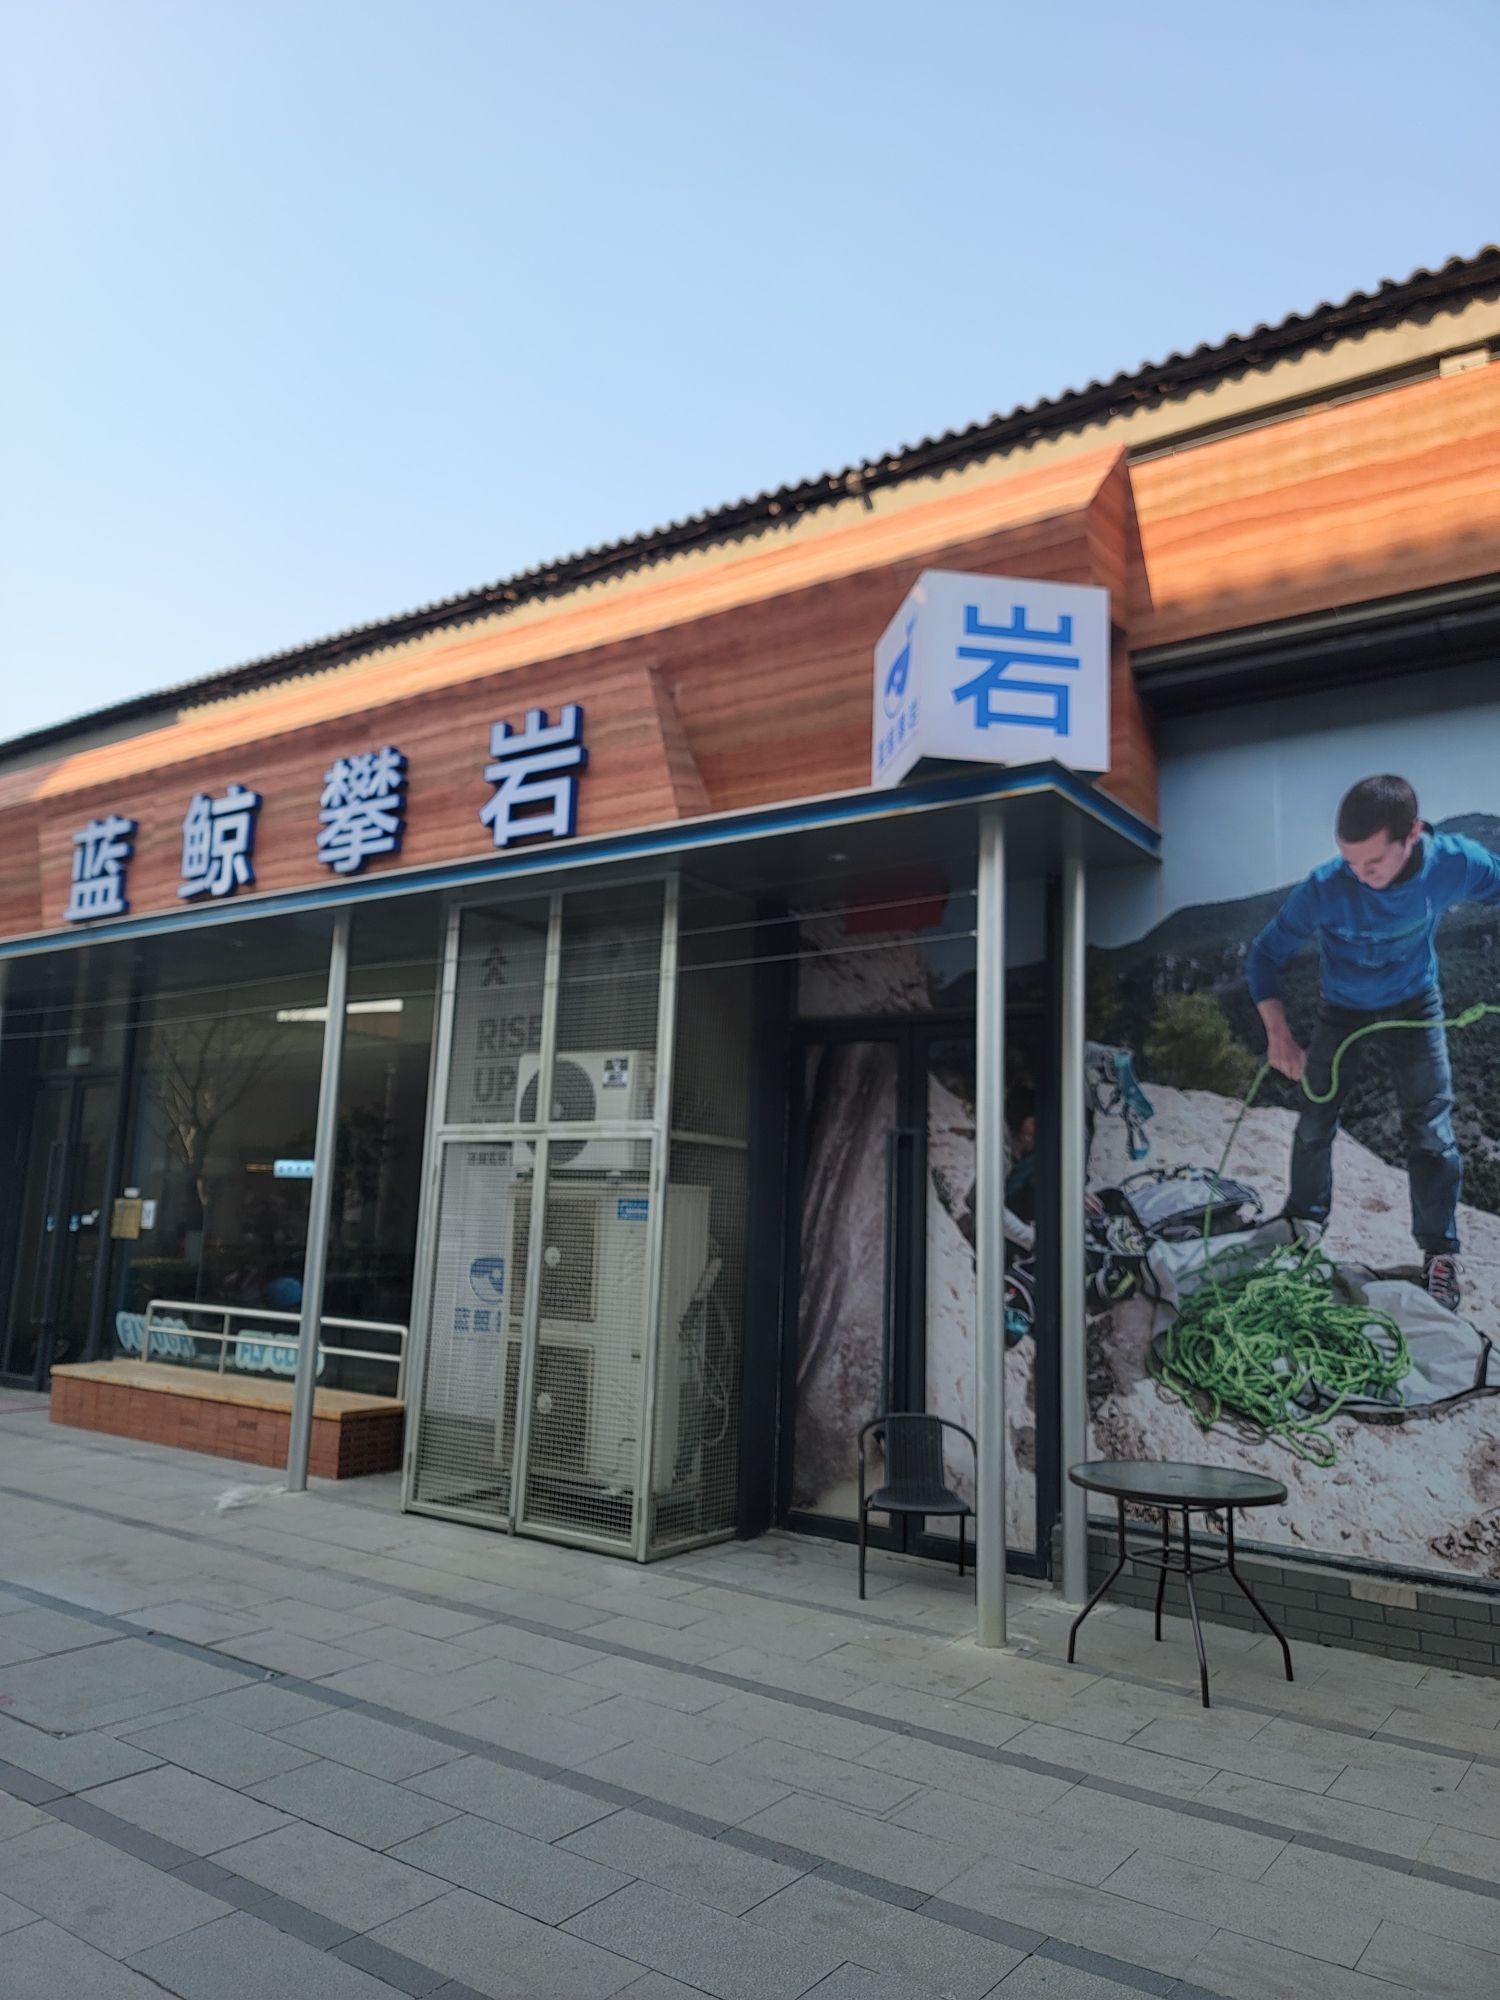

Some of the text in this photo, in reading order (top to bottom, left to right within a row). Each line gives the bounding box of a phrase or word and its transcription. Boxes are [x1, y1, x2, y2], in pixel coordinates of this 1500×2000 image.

[952, 604, 1080, 737] 岩
[64, 703, 588, 923] 蓝鲸攀岩
[476, 1015, 543, 1052] RISE
[474, 1065, 517, 1103] UP
